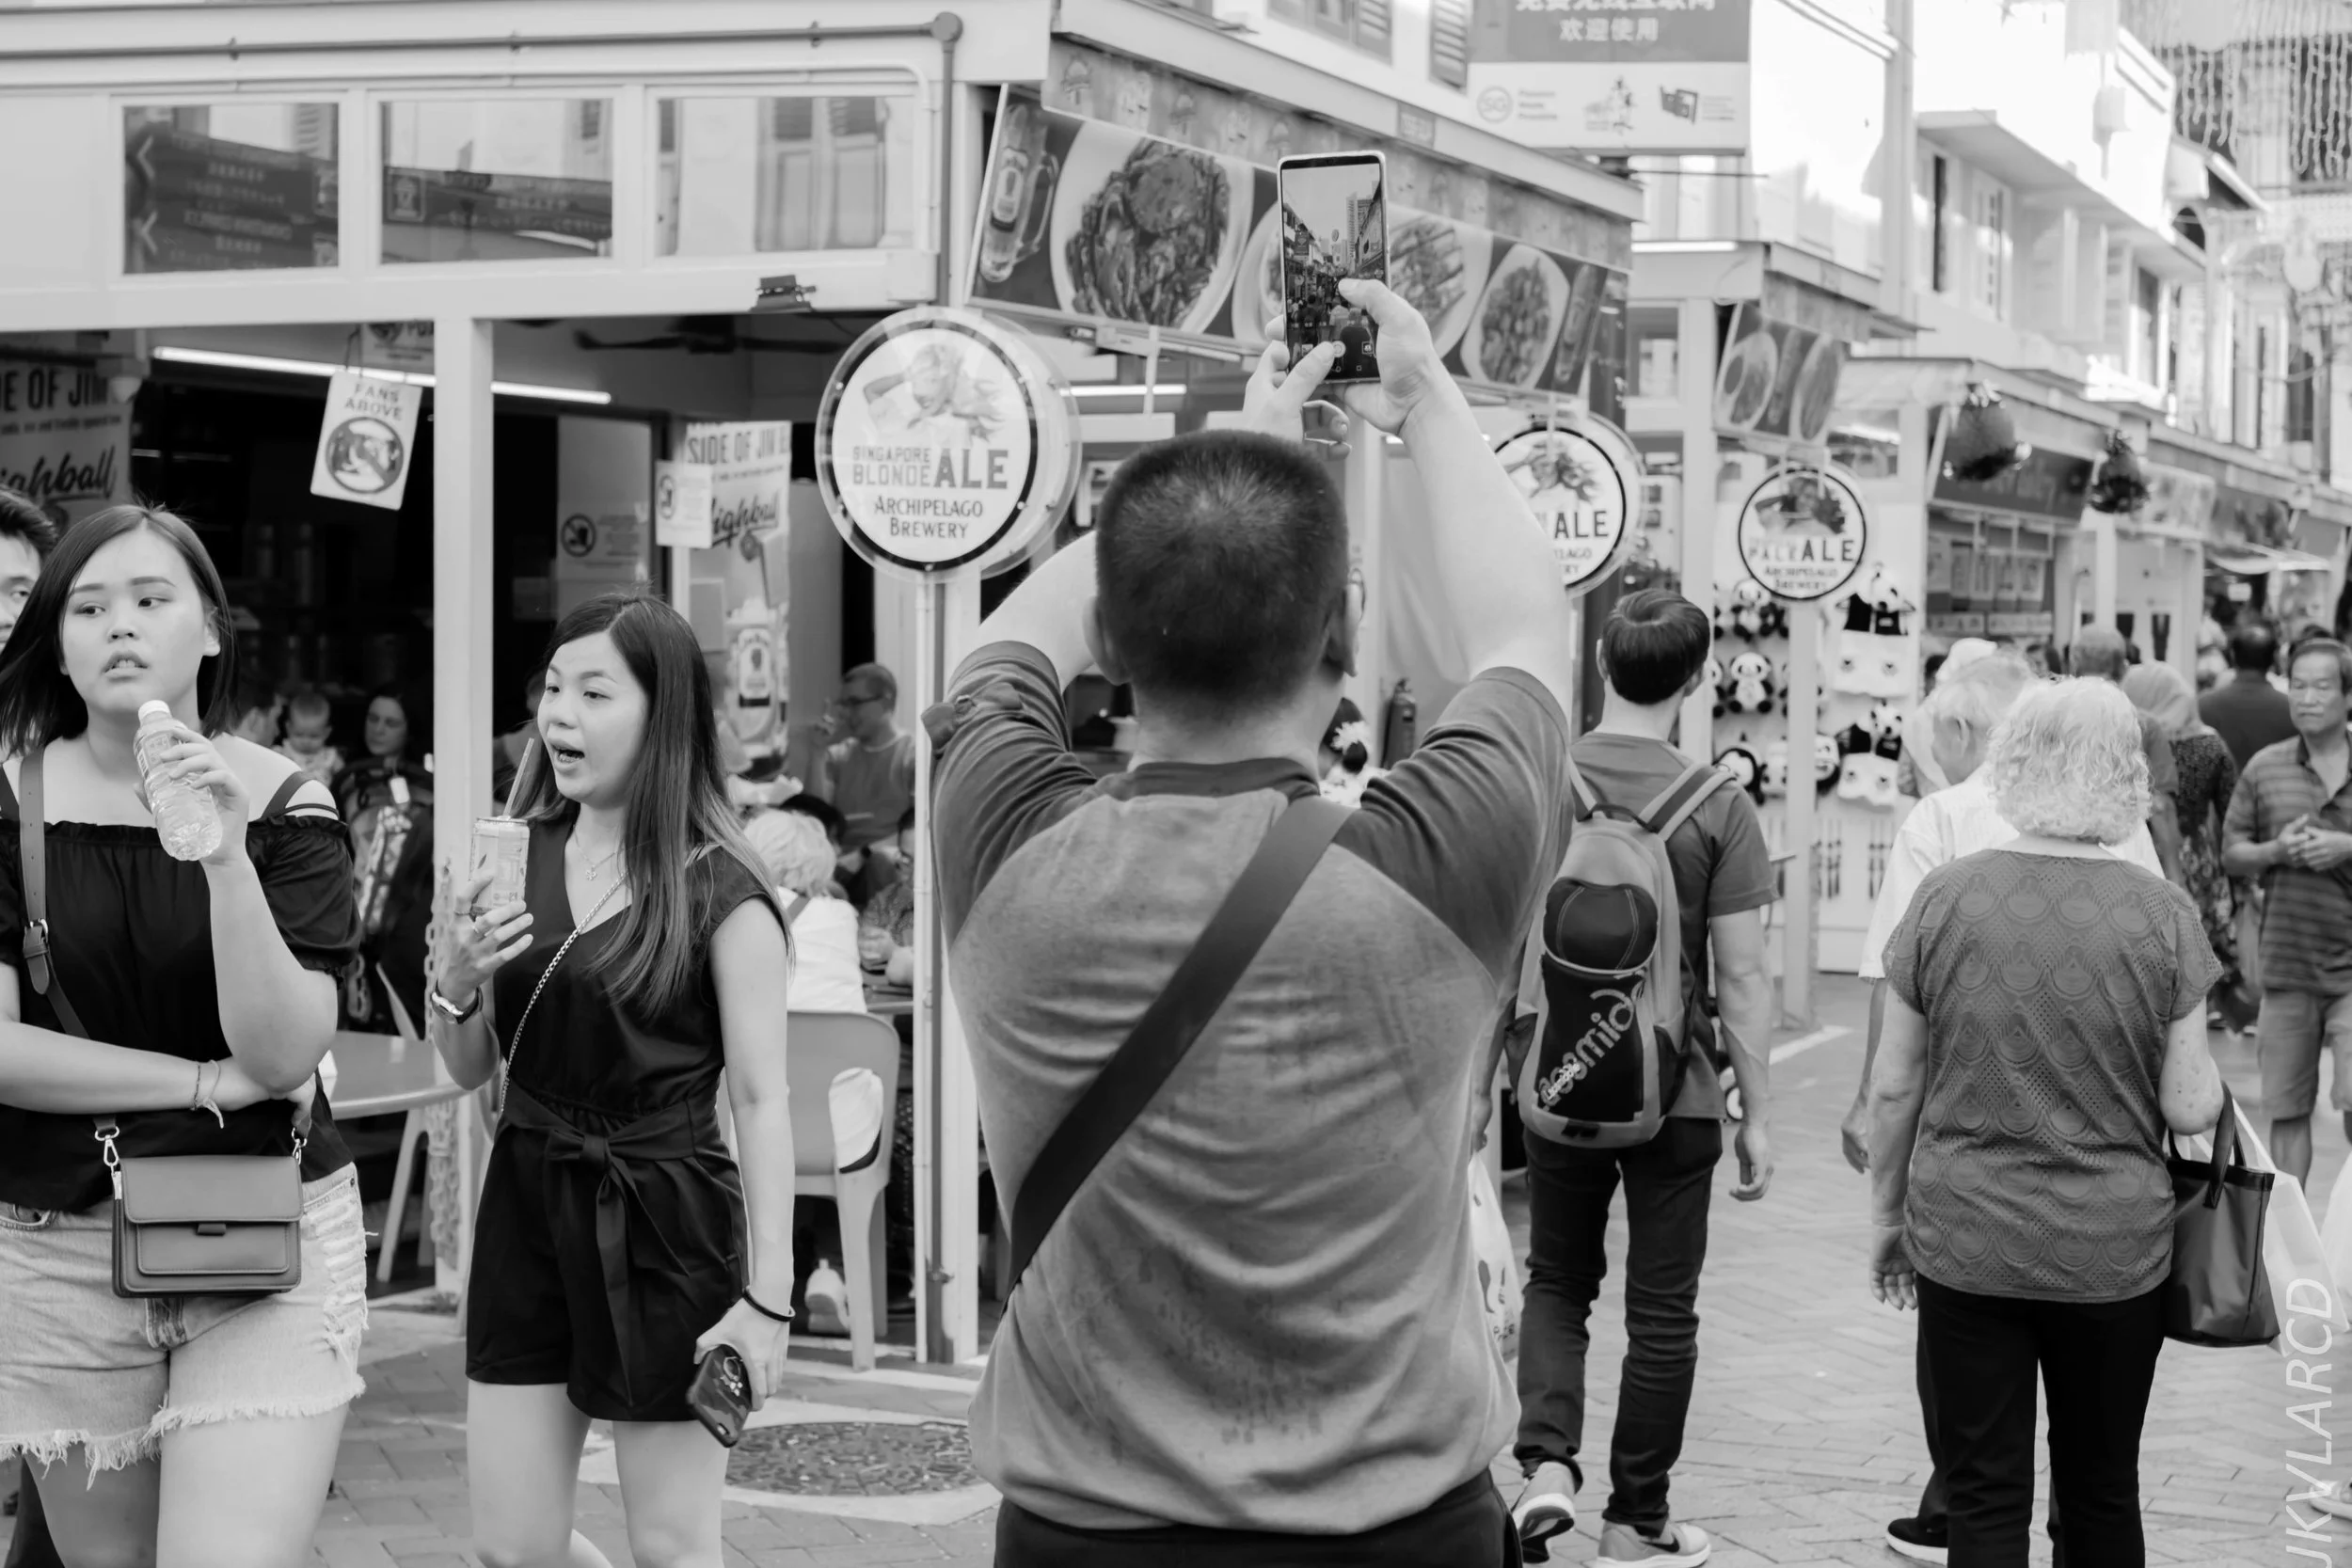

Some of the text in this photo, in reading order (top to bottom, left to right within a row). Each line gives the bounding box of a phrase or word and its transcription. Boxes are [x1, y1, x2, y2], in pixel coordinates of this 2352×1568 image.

[1559, 16, 1659, 41] 欢迎使用
[27, 366, 61, 411] OF
[344, 397, 404, 421] ABOVE
[687, 434, 728, 465] SIDE
[852, 445, 931, 463] SINGAPORE
[852, 447, 1009, 490] BLONDE ALE
[874, 495, 984, 518] ARCHIPELAGO
[889, 517, 969, 540] BREWERY
[1554, 510, 1609, 539] ALE
[1801, 539, 1854, 562] ALE
